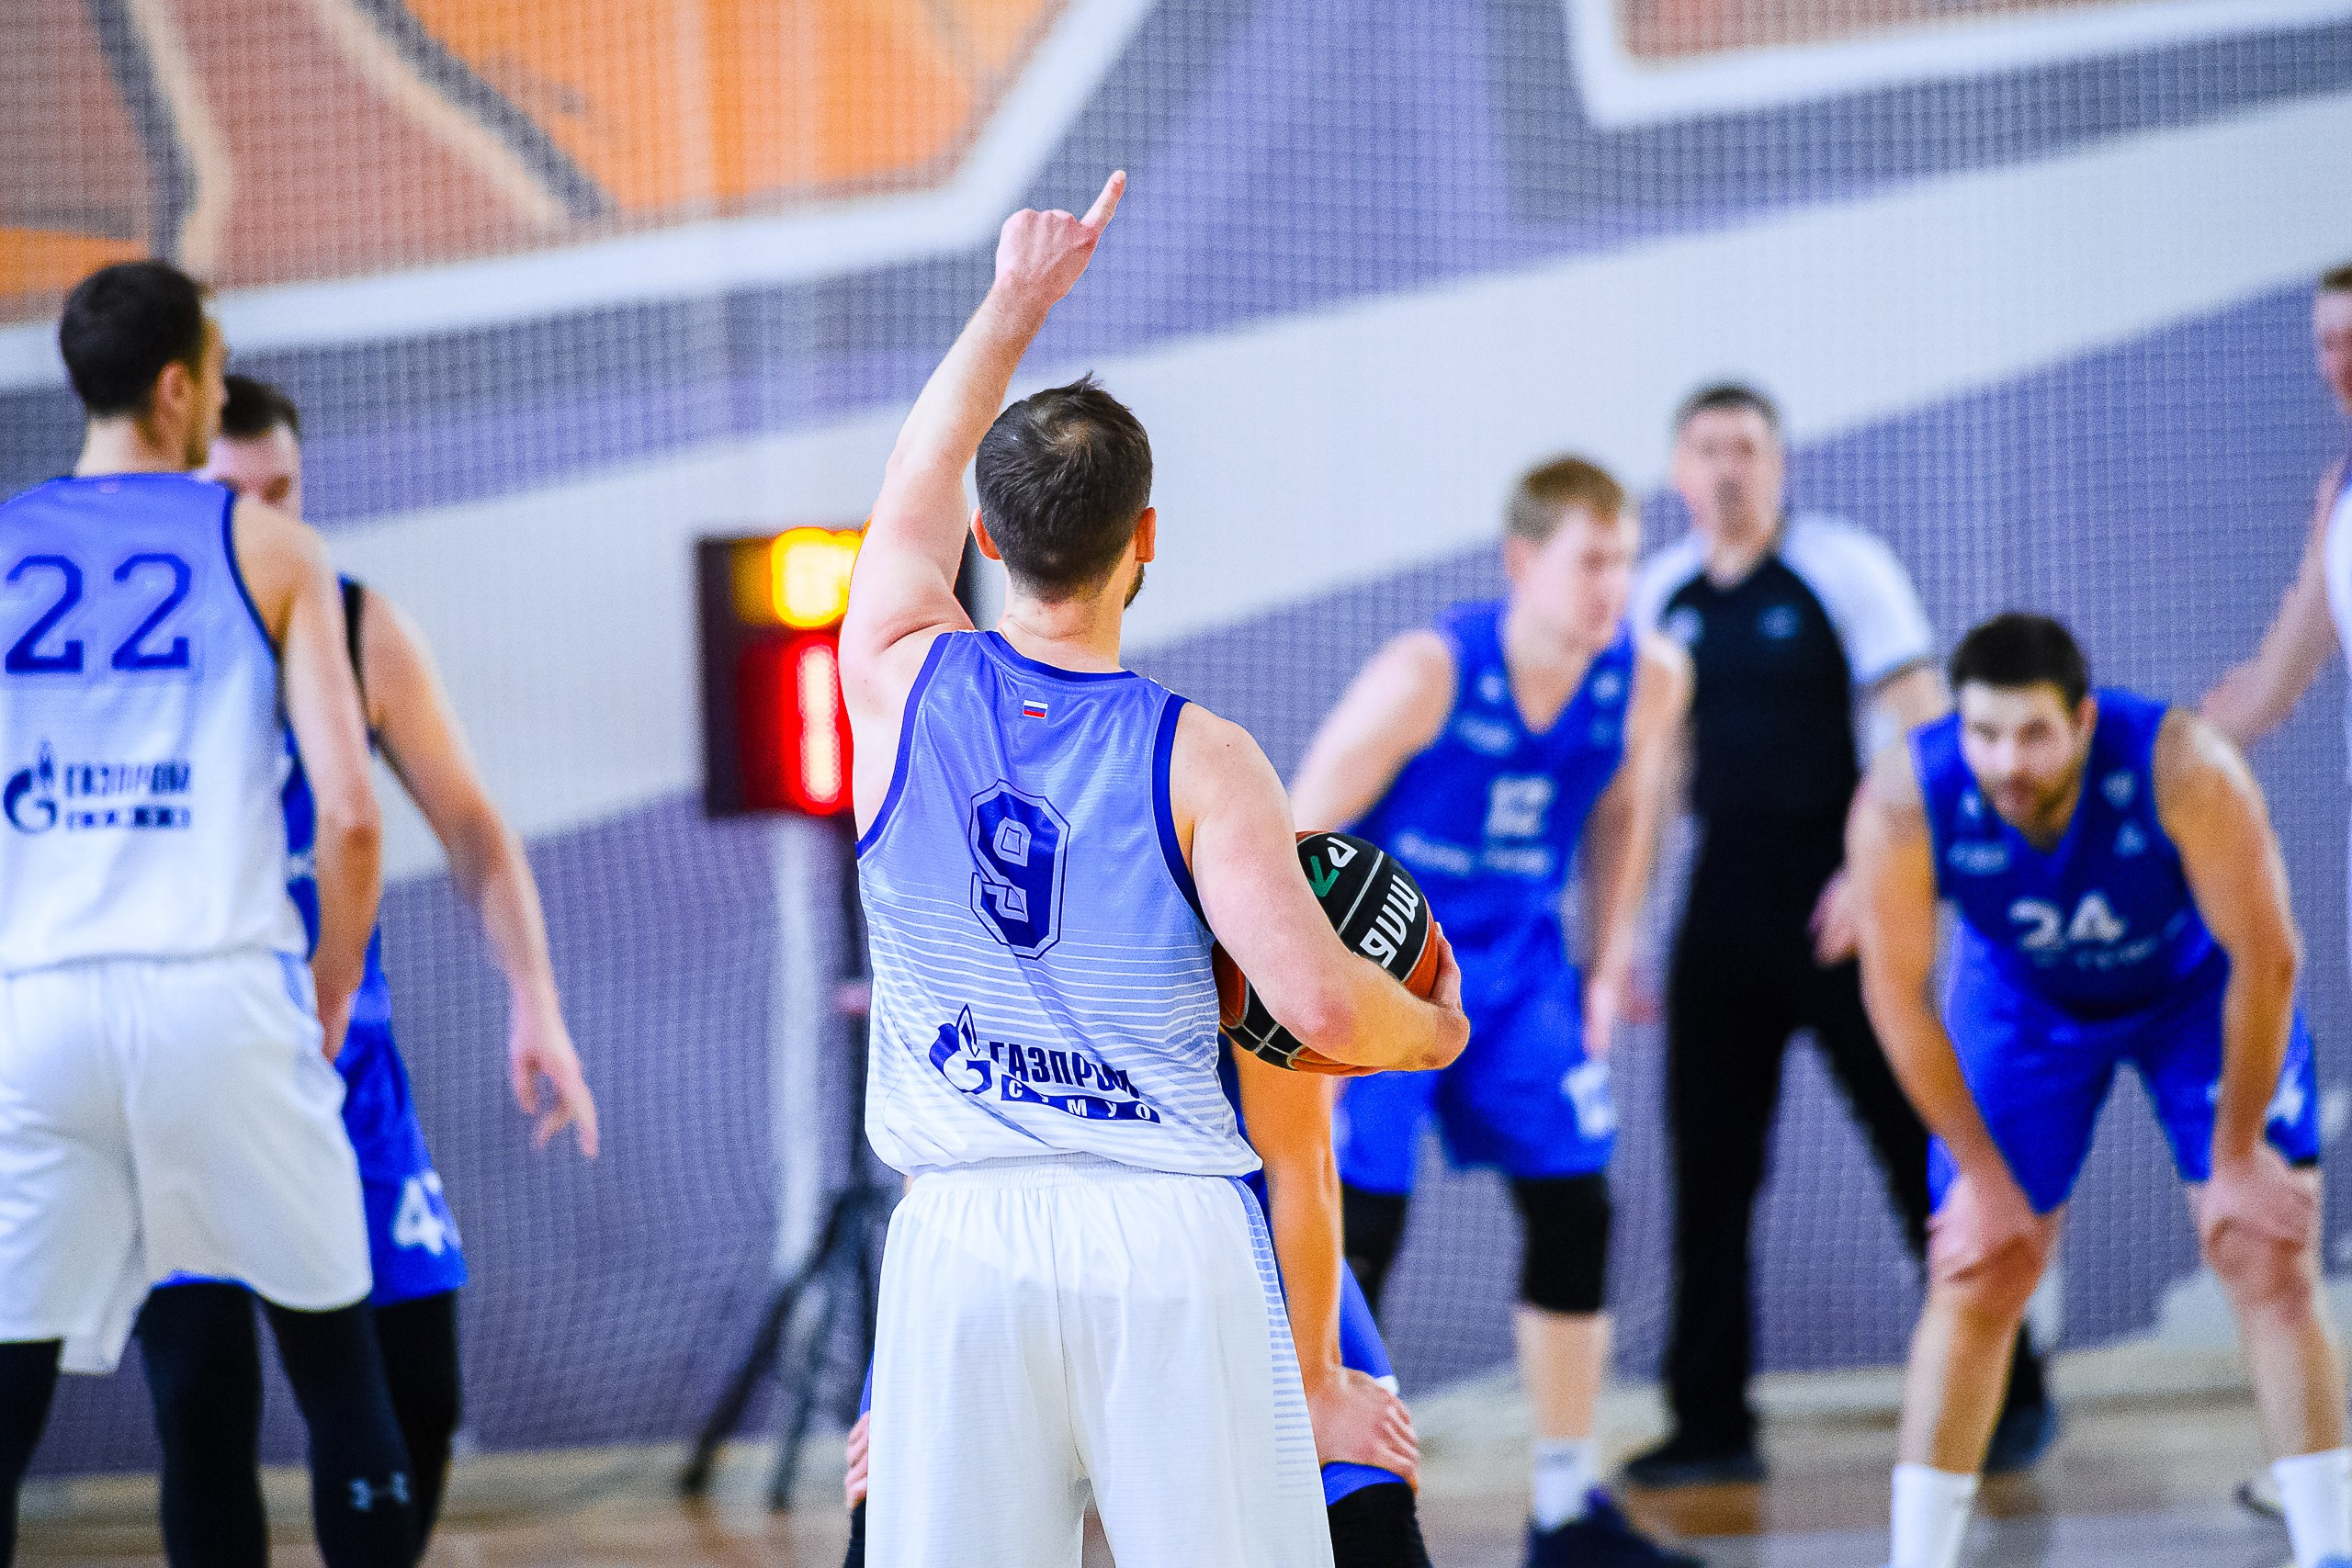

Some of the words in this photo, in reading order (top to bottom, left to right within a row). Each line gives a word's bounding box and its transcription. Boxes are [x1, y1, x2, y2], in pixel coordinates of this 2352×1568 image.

[5, 552, 192, 674] 22
[969, 778, 1071, 961] 9
[2006, 889, 2128, 952] 24
